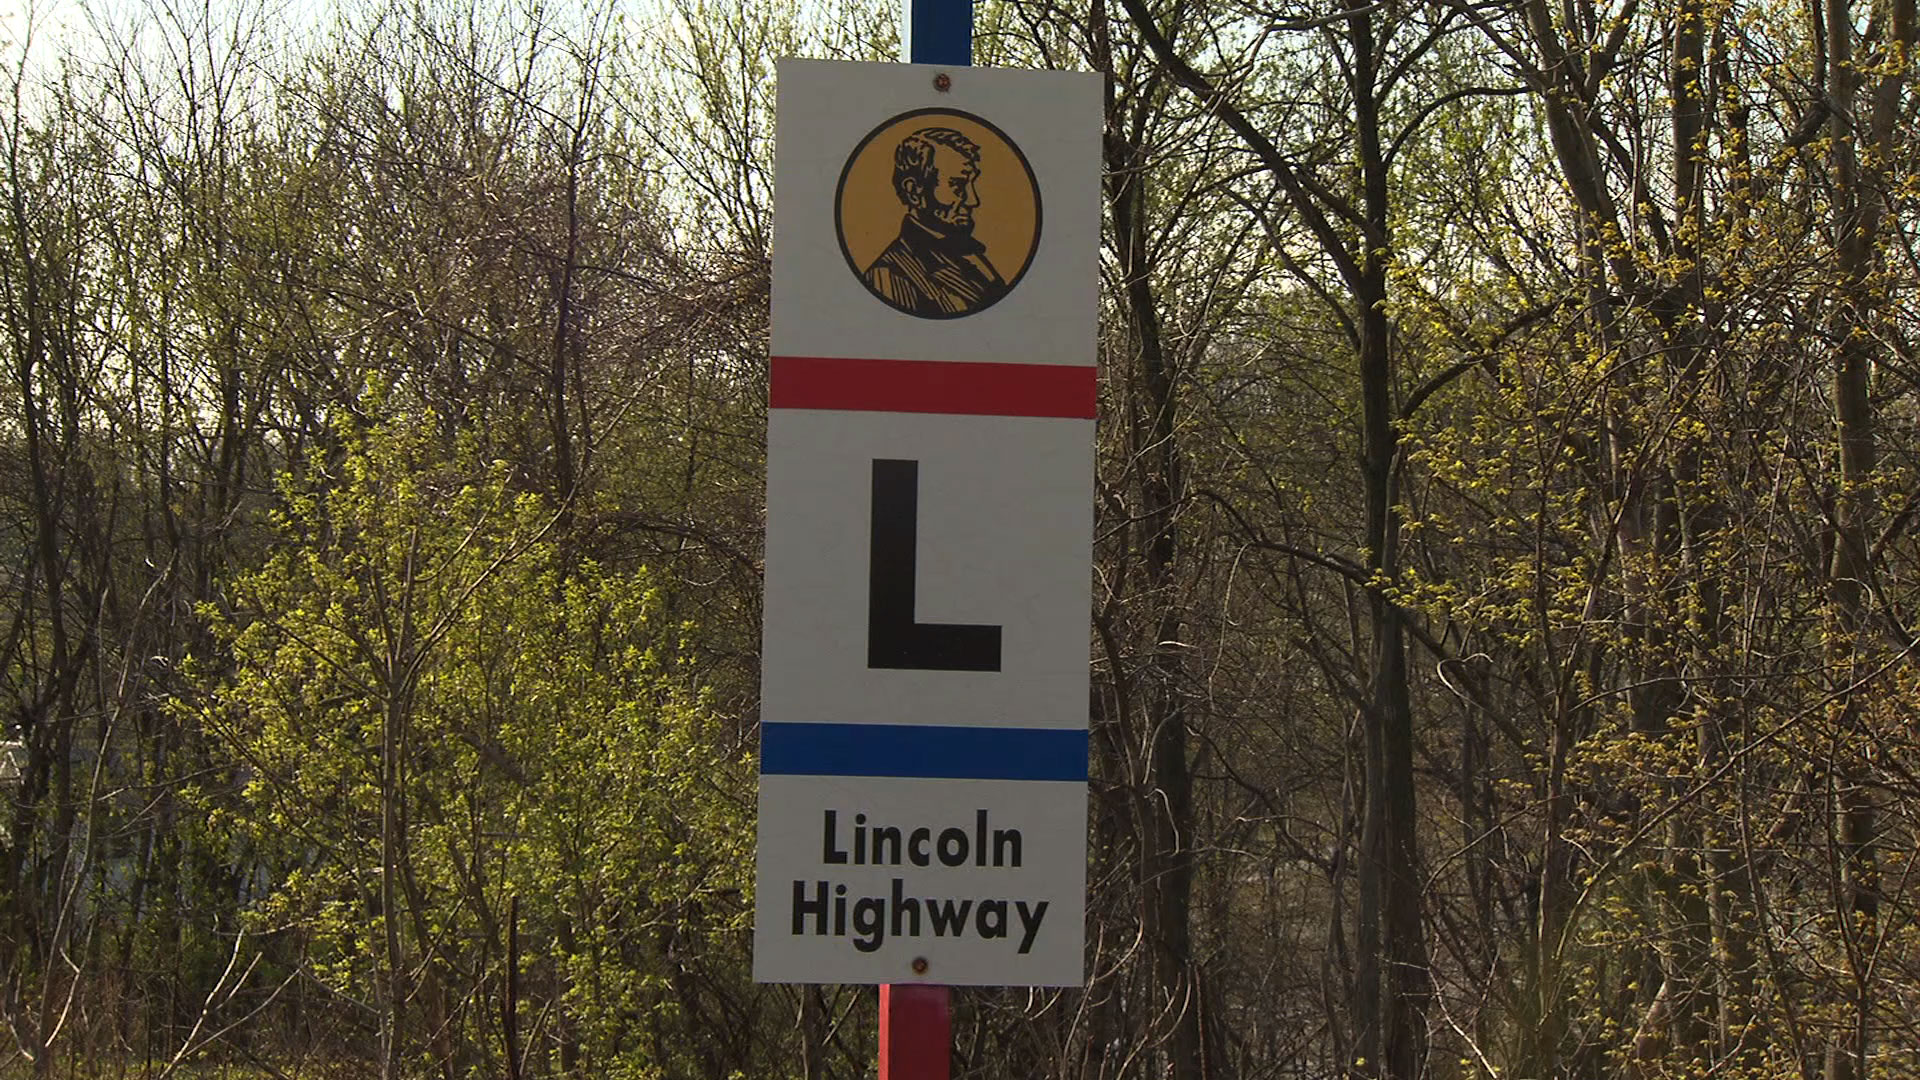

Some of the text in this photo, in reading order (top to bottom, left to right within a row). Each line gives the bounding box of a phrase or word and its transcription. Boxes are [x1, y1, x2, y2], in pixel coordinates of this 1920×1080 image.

[868, 459, 1002, 672] L
[823, 809, 1022, 867] Lincoln
[792, 878, 1050, 954] Highway
